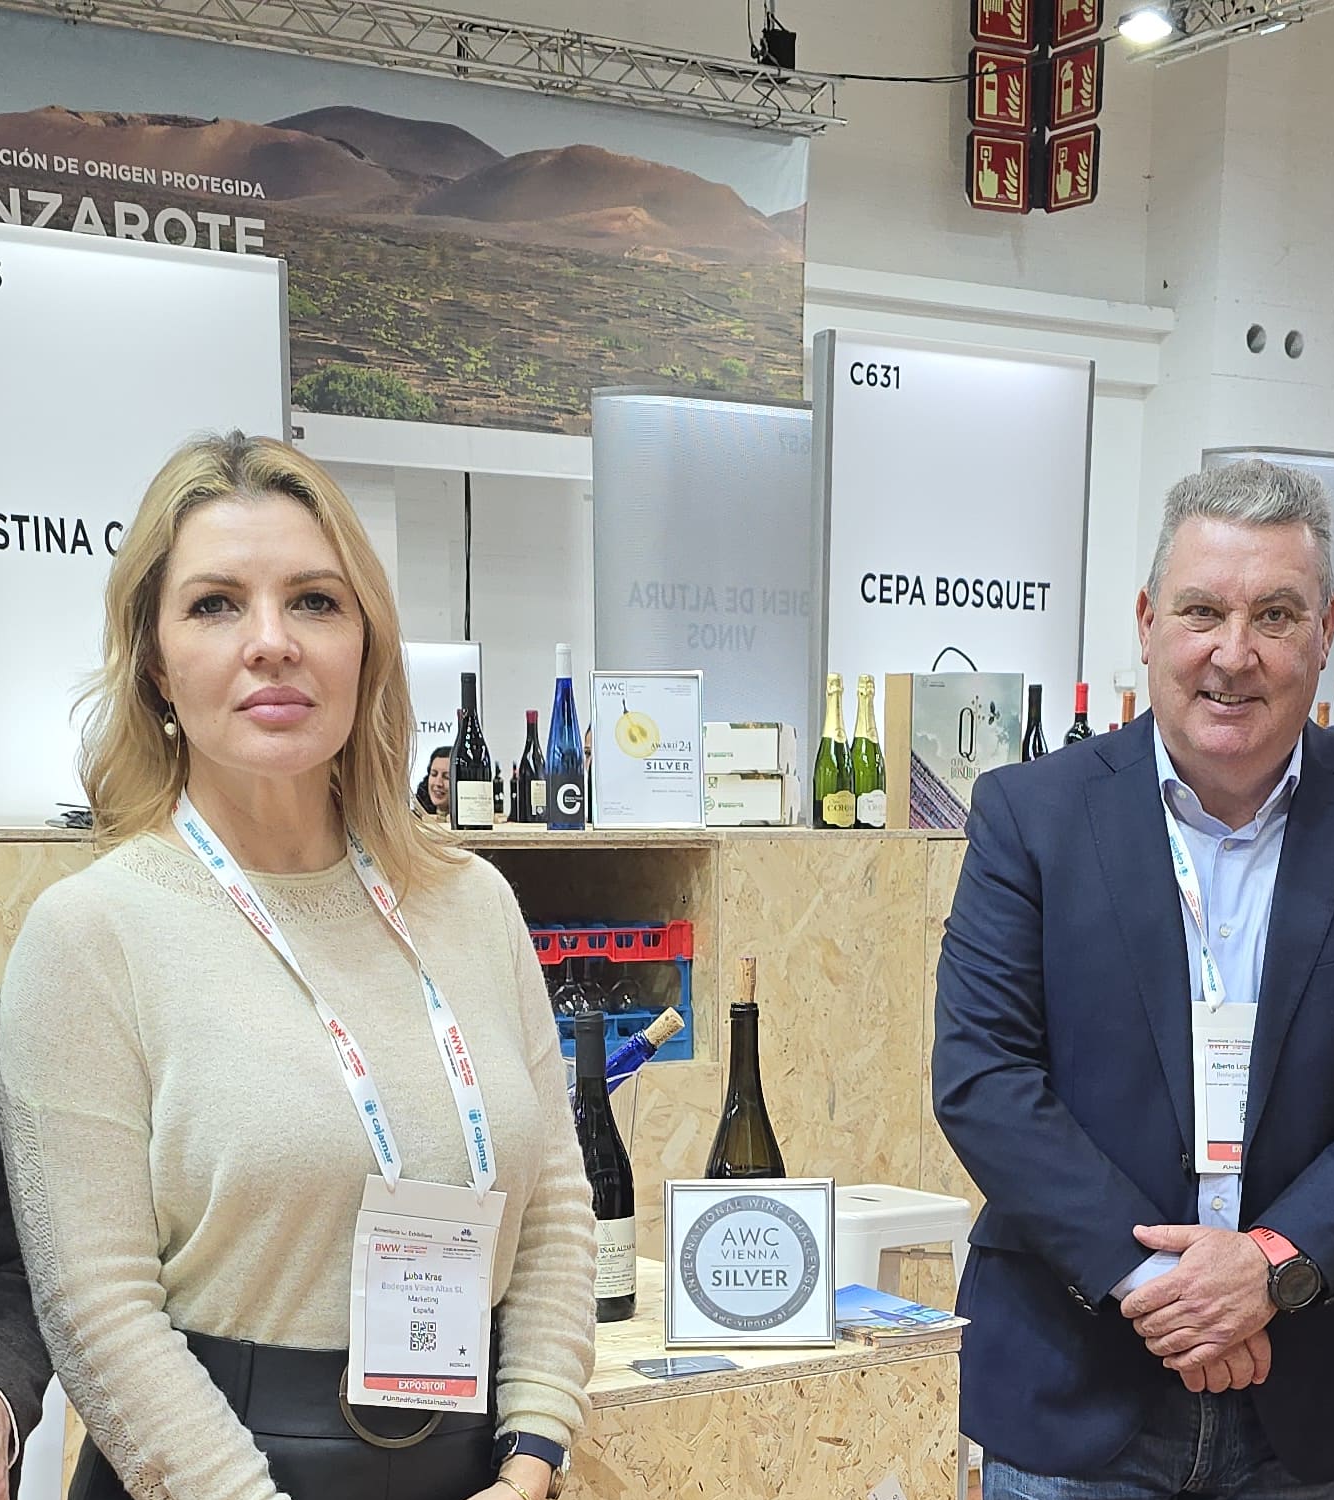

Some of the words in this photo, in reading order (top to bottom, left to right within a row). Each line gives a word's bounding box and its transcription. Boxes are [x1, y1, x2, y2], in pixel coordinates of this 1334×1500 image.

[54, 155, 79, 175] DE
[84, 160, 157, 186] ORIGEN
[161, 169, 266, 200] PROTEGIDA
[850, 361, 900, 389] C631
[860, 572, 926, 606] CEPA
[935, 576, 1051, 611] BOSQUET
[646, 762, 690, 771] SILVER
[557, 783, 582, 814] C
[448, 1025, 465, 1055] BWW
[372, 1118, 394, 1164] cajamar
[474, 1126, 489, 1173] cajamar
[721, 1227, 779, 1247] AWC
[721, 1250, 779, 1260] VIENNA
[711, 1269, 788, 1287] SILVER
[408, 1295, 439, 1304] Marketing
[398, 1379, 446, 1391] EXPOSITOR
